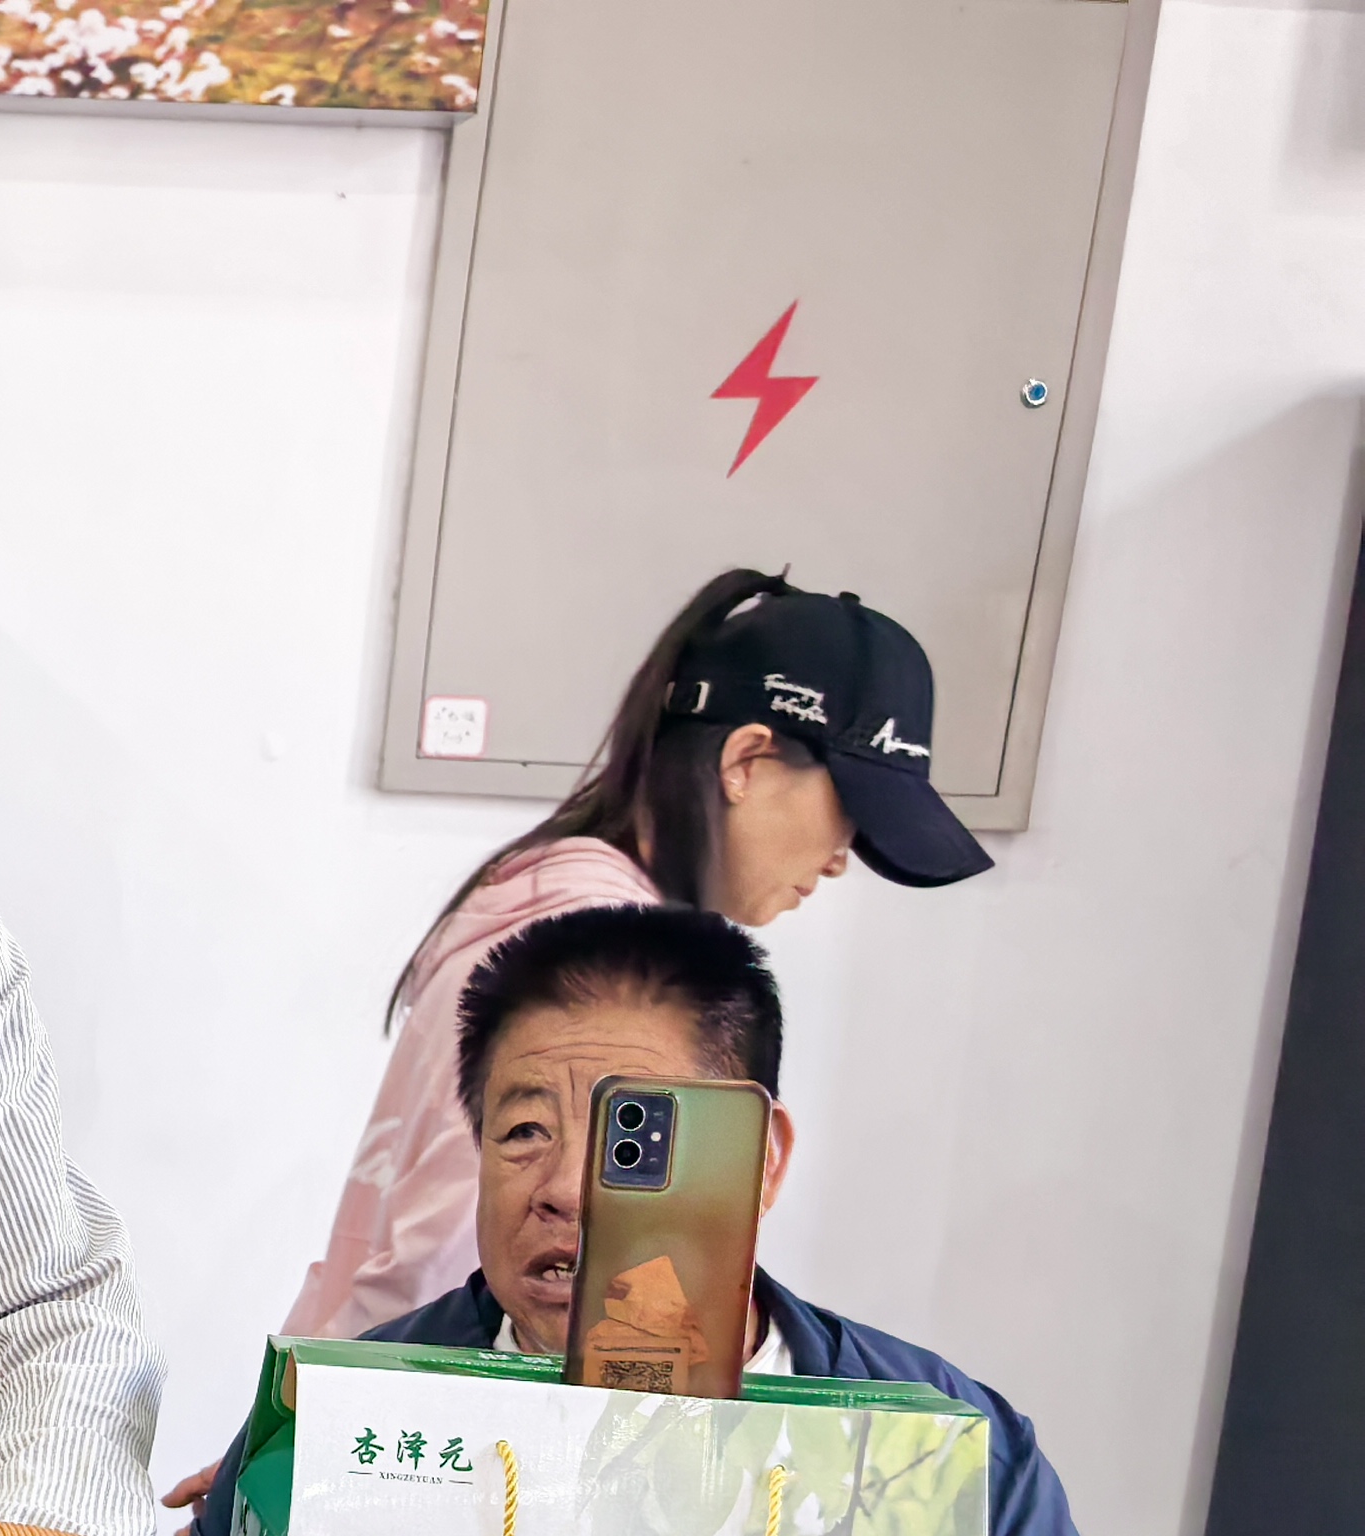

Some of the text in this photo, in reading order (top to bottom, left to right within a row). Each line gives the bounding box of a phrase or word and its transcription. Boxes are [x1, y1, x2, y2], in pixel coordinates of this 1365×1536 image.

[350, 1427, 473, 1472] 杏泽元
[378, 1471, 443, 1485] XINGZEYUAN
